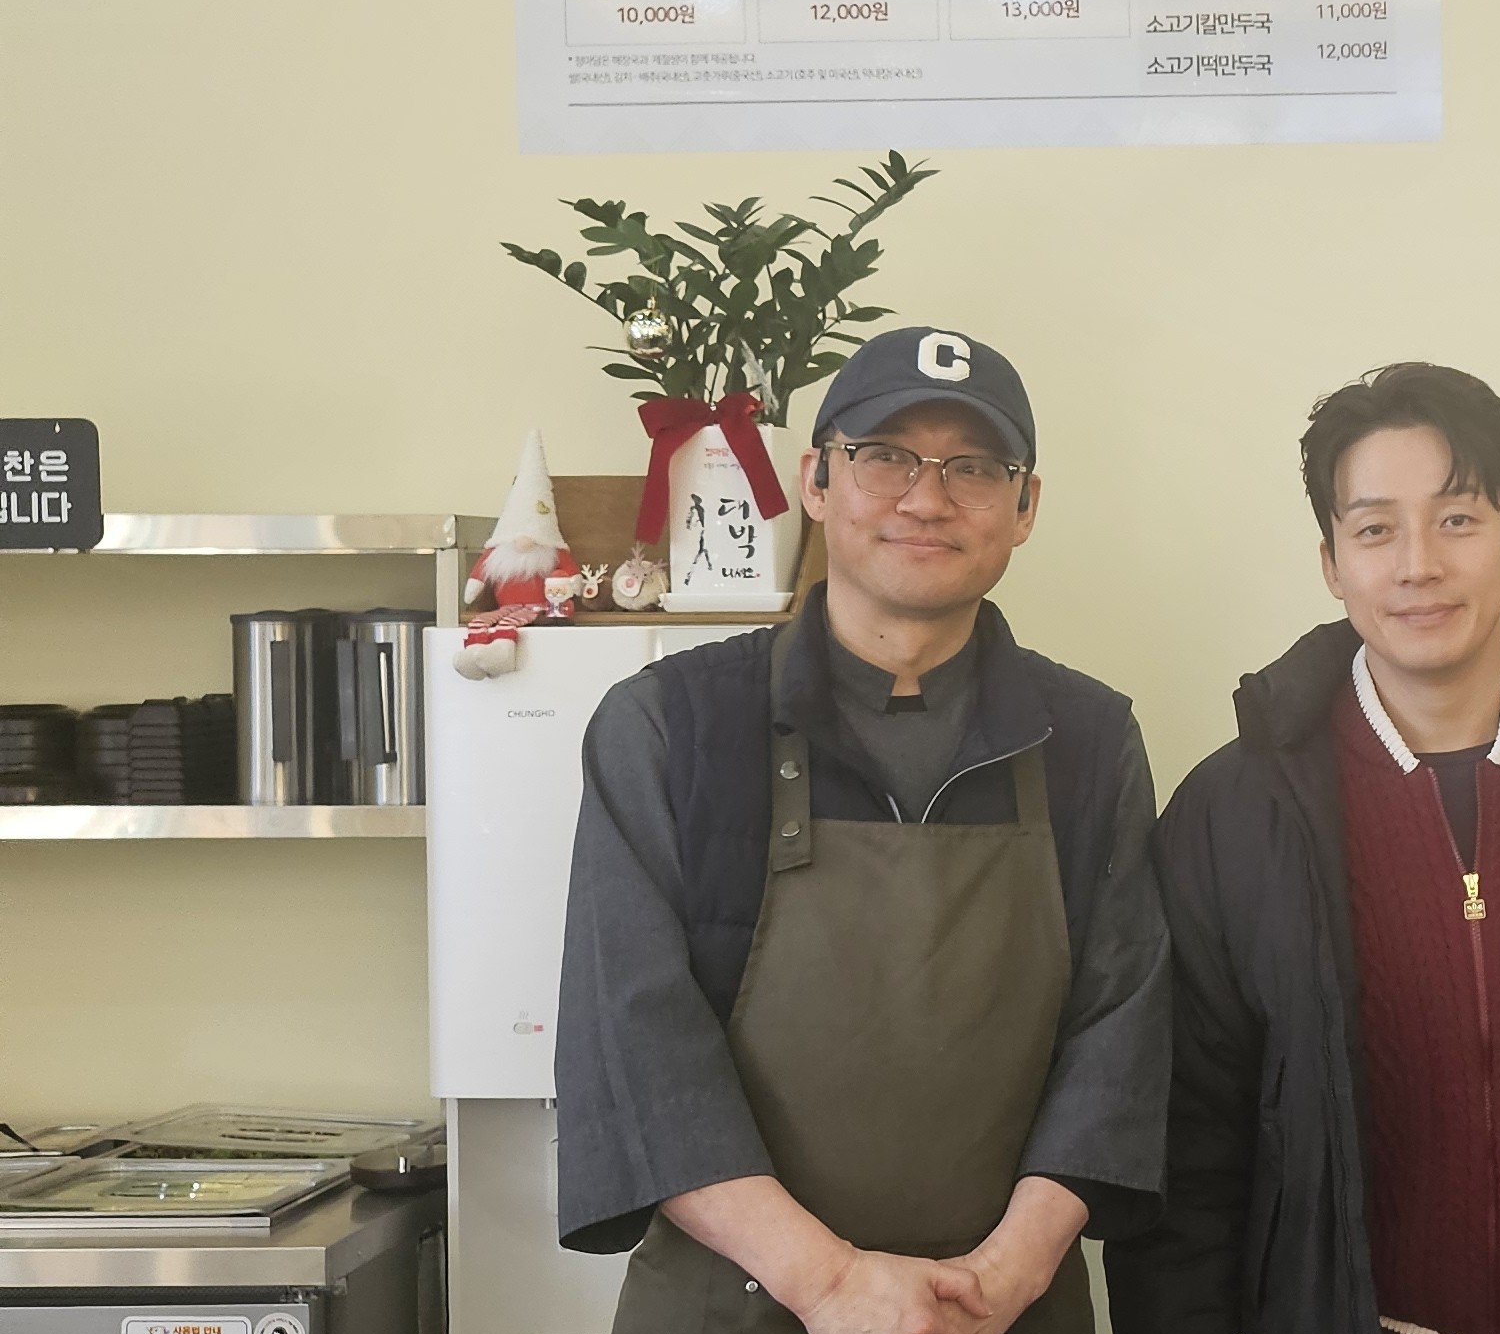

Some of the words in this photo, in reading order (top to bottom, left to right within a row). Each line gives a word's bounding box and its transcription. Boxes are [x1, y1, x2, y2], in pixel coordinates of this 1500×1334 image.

[616, 3, 696, 25] 10,000원
[810, 2, 889, 24] 12,000원
[1316, 1, 1388, 22] 11,000원
[1146, 13, 1273, 35] 소고기칼만두국
[1317, 40, 1388, 62] 12,000원
[1147, 53, 1274, 78] 소고기떡만두국
[917, 331, 971, 382] C
